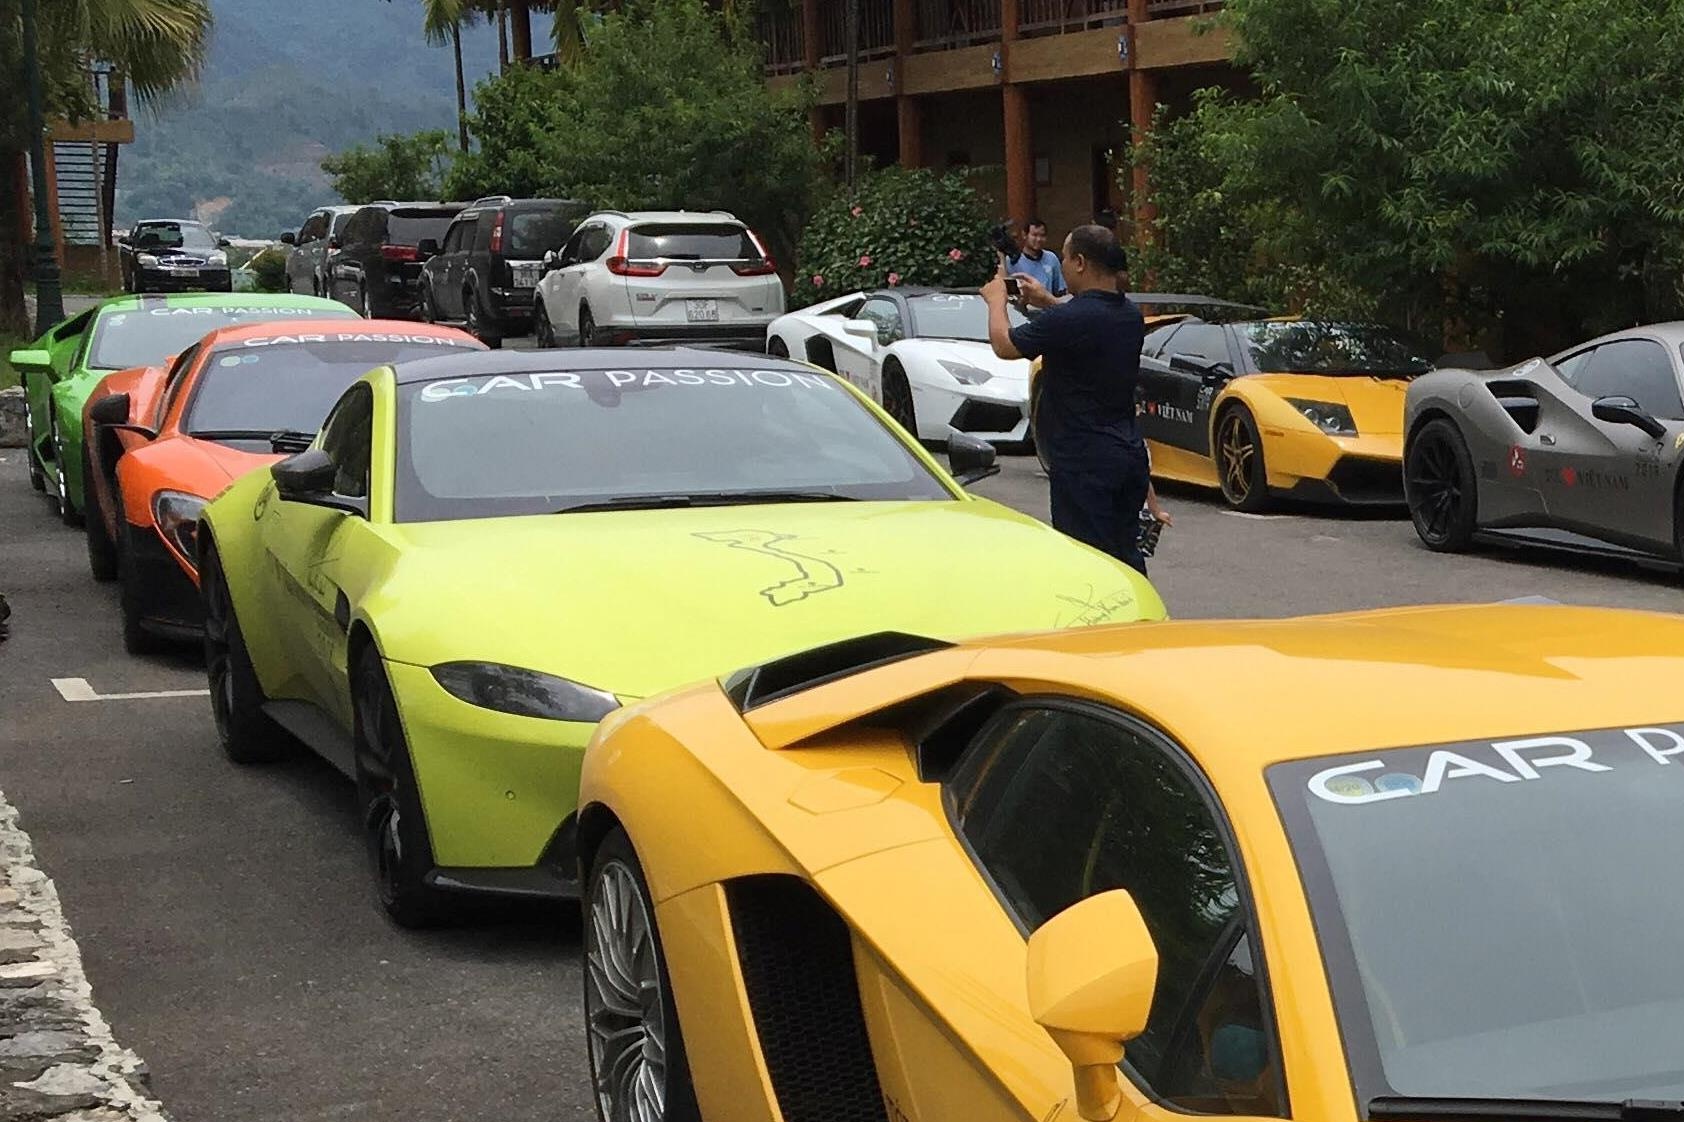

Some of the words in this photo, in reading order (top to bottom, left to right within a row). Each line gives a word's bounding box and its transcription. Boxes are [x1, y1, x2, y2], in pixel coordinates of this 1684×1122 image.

[150, 307, 212, 316] CAR
[222, 307, 312, 315] PASSION
[244, 334, 326, 346] CAR
[336, 334, 455, 346] PASSION
[421, 372, 584, 402] CAR
[605, 369, 833, 391] PASSION
[1307, 736, 1614, 804] CAR
